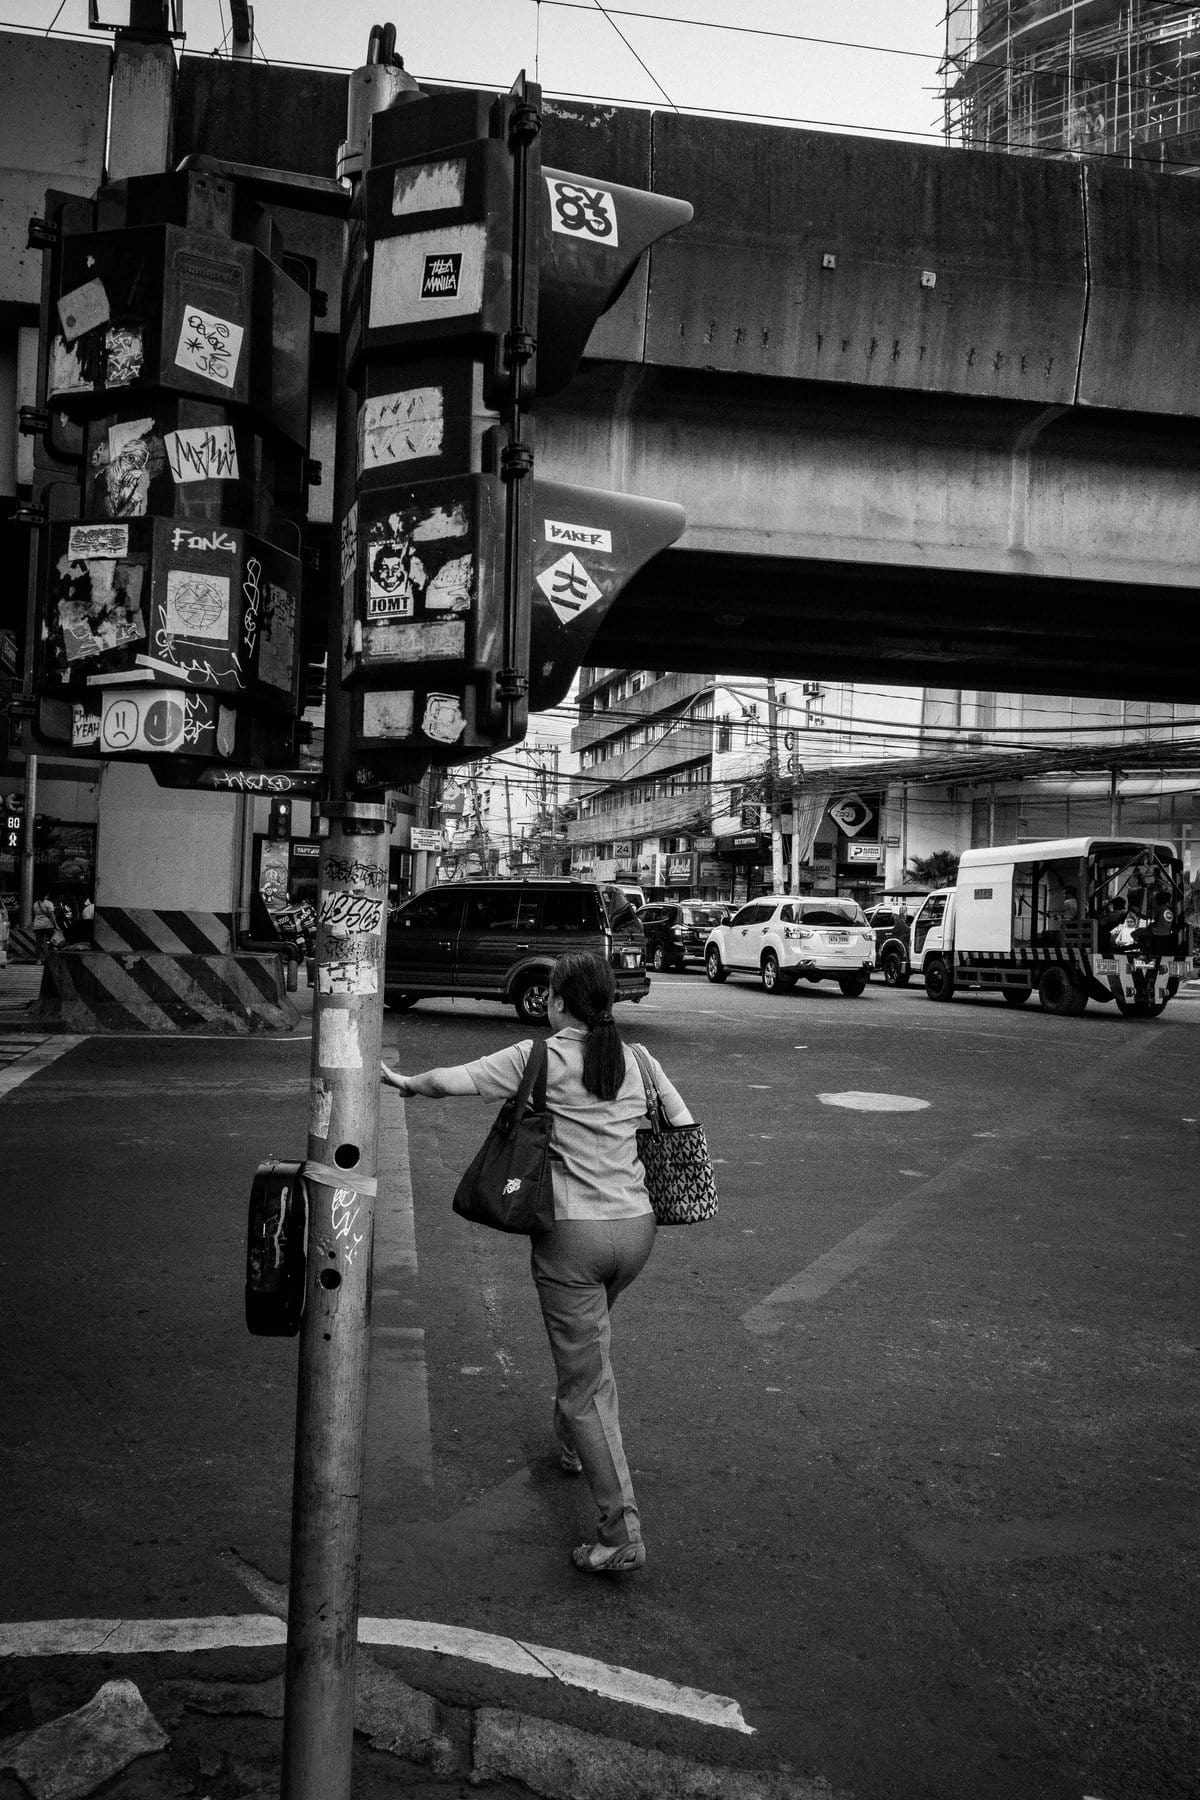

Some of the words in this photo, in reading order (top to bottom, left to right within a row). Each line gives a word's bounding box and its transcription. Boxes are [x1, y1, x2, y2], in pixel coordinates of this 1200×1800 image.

[423, 274, 457, 293] MANILA
[371, 596, 410, 613] JOMT
[75, 722, 100, 738] YEAH
[8, 817, 20, 829] 80
[616, 845, 629, 853] 24
